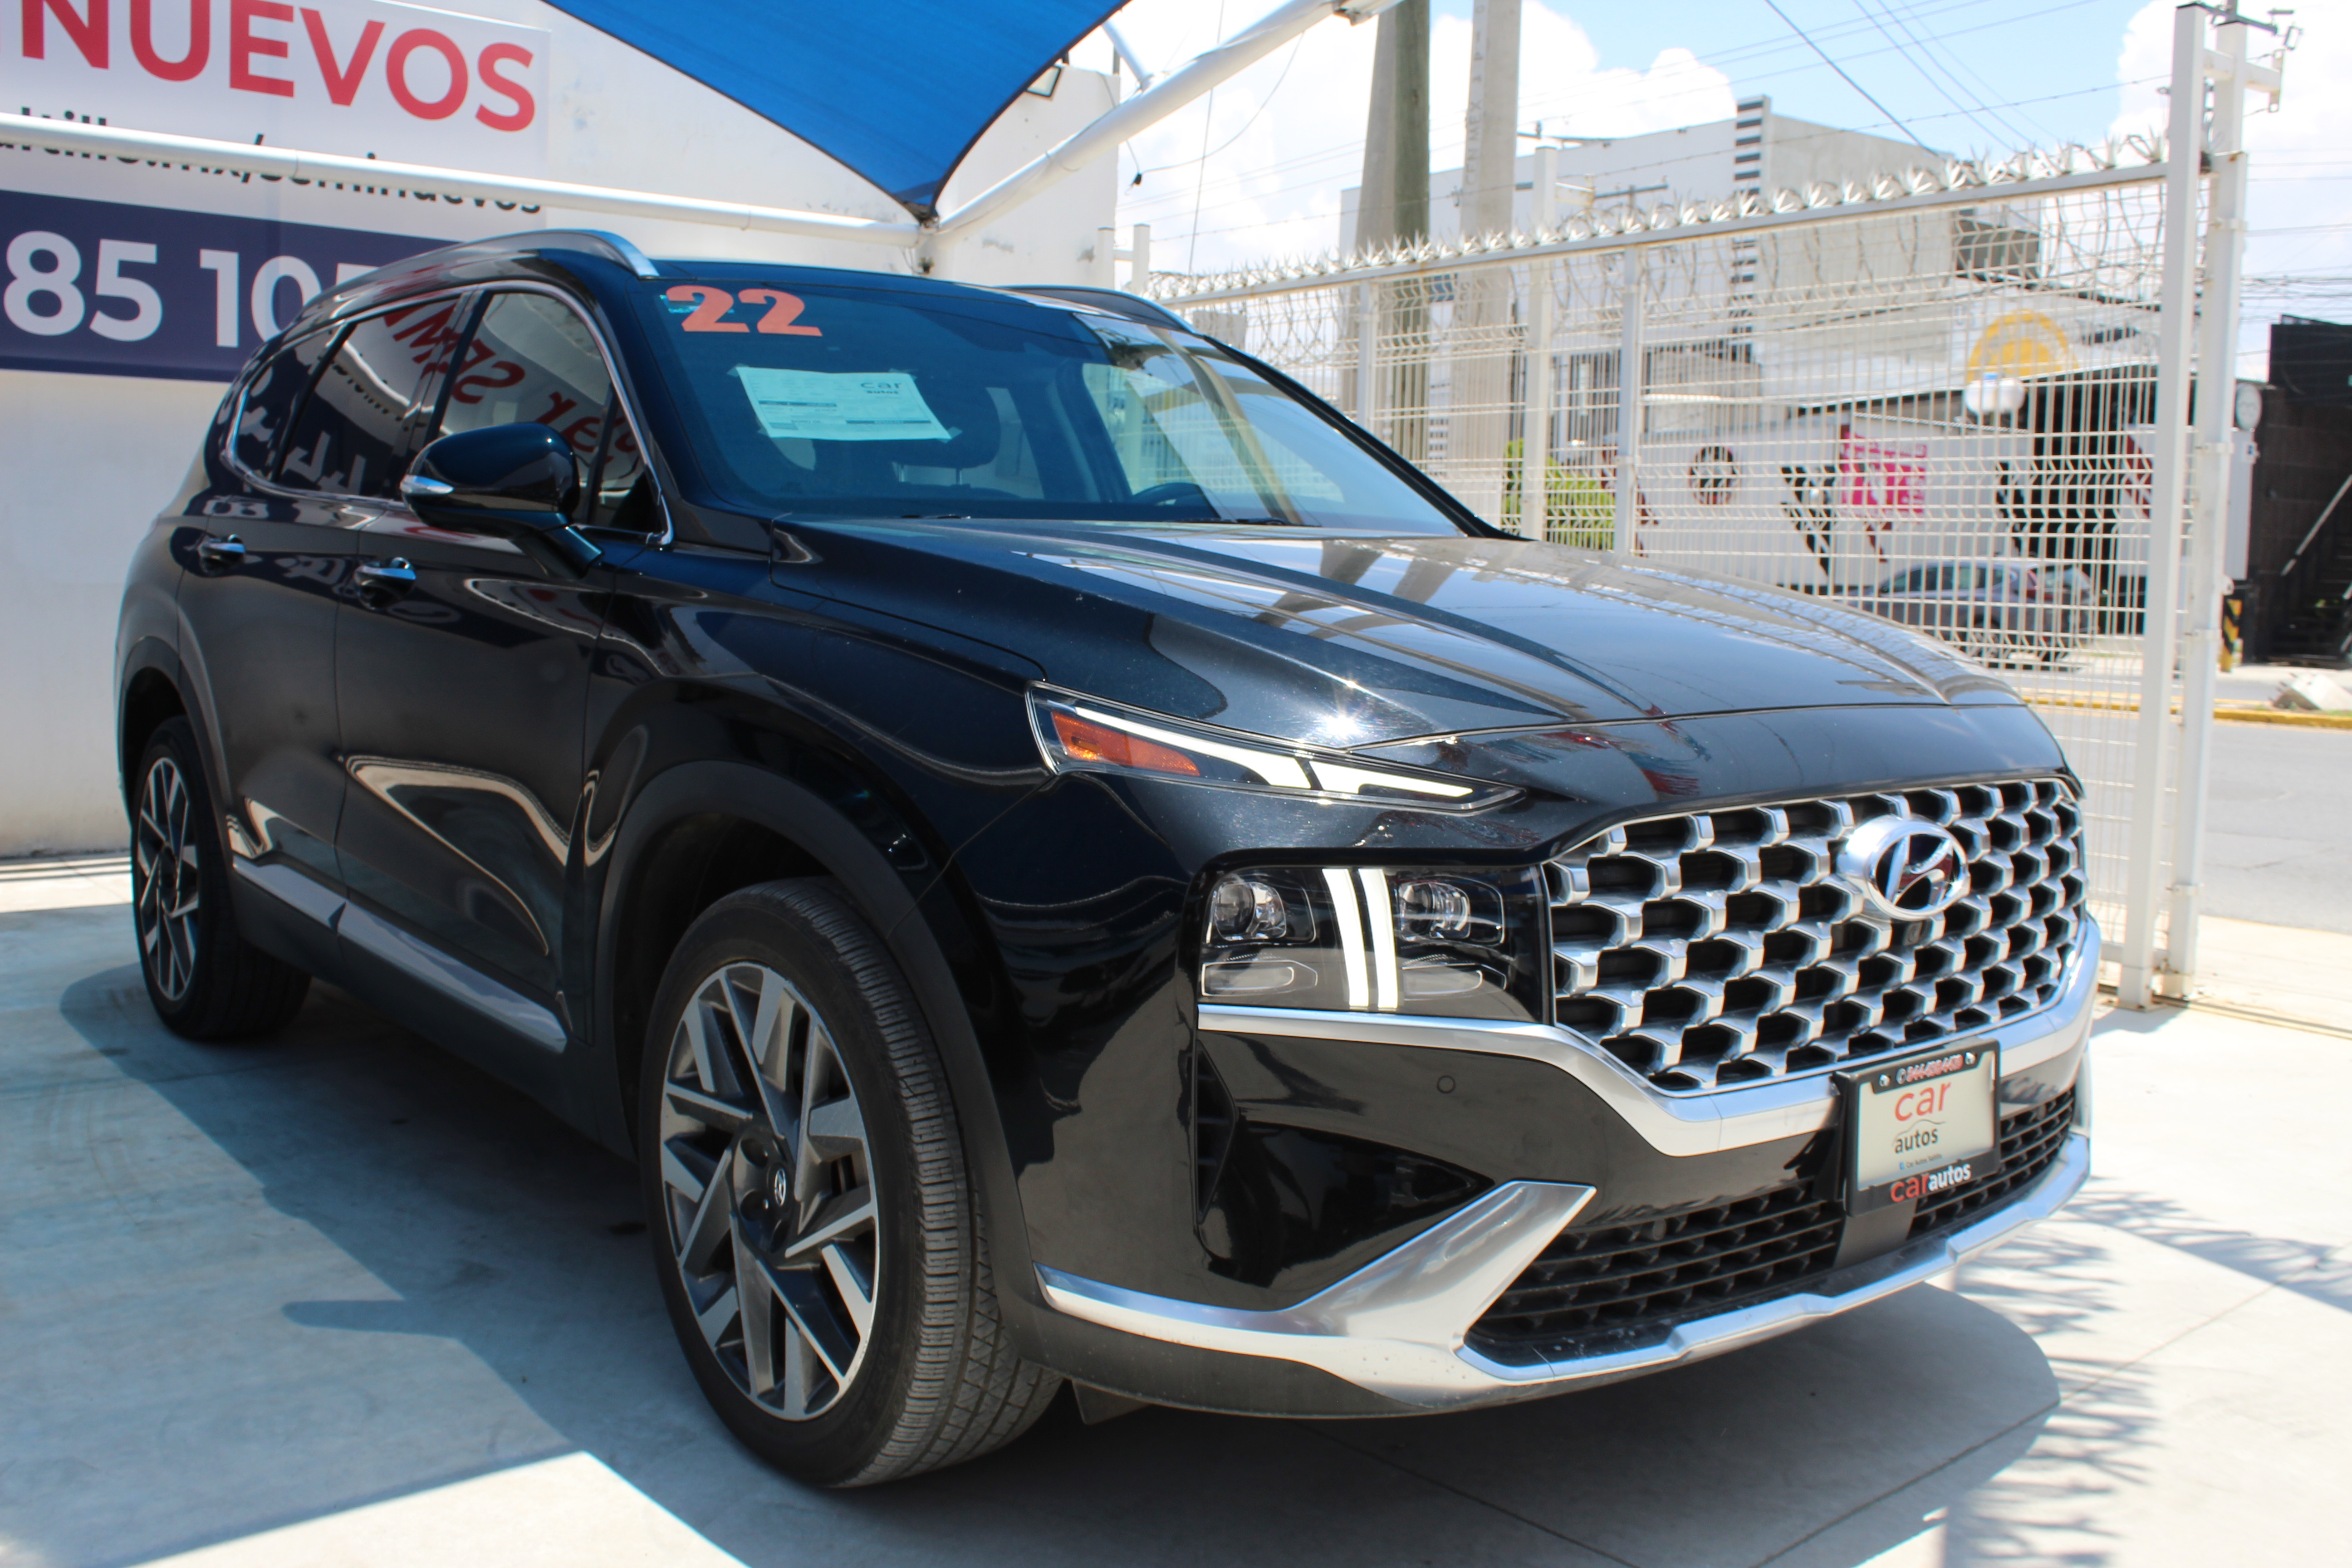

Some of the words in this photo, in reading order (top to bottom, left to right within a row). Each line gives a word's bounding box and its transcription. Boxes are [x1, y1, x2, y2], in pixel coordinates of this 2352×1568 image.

[21, 0, 536, 132] NUEVOS
[4, 230, 163, 342] 85
[200, 248, 380, 348] 10
[666, 285, 823, 336] 22
[1895, 1082, 1951, 1122] car
[1894, 1128, 1938, 1154] autos
